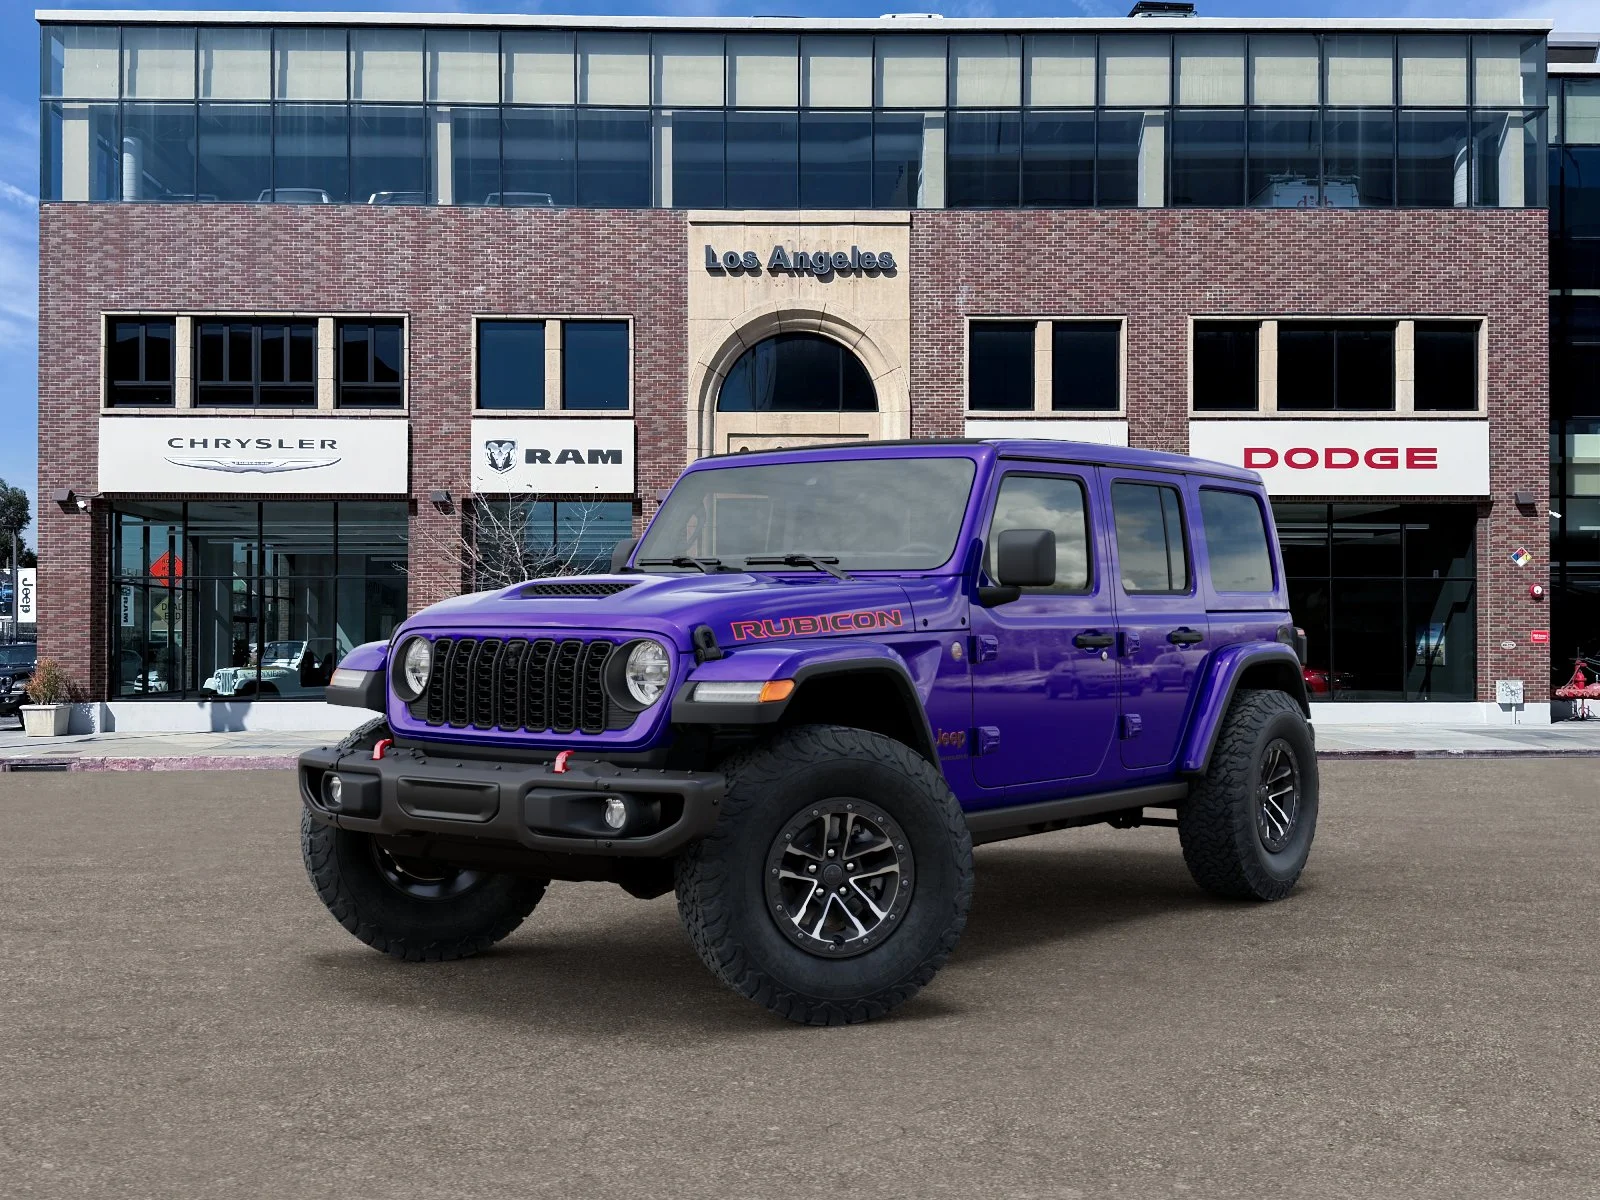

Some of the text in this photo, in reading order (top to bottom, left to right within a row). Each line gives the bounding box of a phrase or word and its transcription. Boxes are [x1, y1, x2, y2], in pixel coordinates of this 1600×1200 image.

[704, 244, 895, 275] Los Angeles
[167, 437, 338, 450] CHRYSLER
[524, 448, 623, 465] RAM
[1243, 447, 1438, 470] DODGE
[20, 577, 34, 614] Jeep
[164, 612, 181, 620] ED
[730, 609, 903, 641] RUBICON
[936, 727, 966, 749] Jeep
